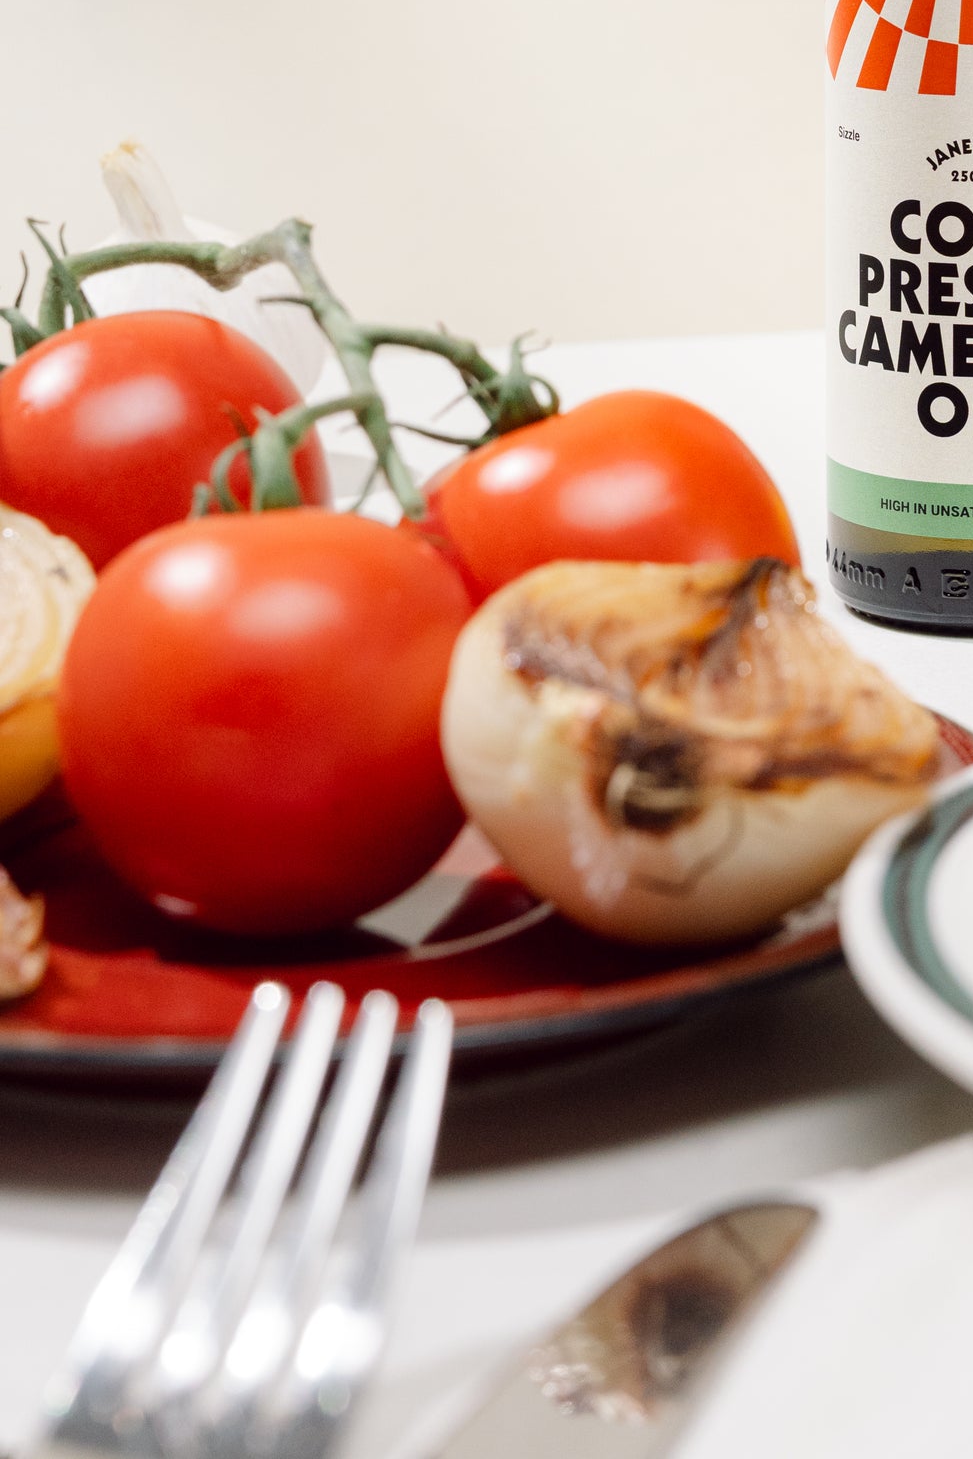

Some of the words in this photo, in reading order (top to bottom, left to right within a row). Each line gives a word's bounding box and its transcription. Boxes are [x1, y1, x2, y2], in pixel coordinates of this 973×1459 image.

[838, 125, 861, 142] Sizzle
[880, 498, 910, 513] HIGH
[913, 502, 928, 516] IN
